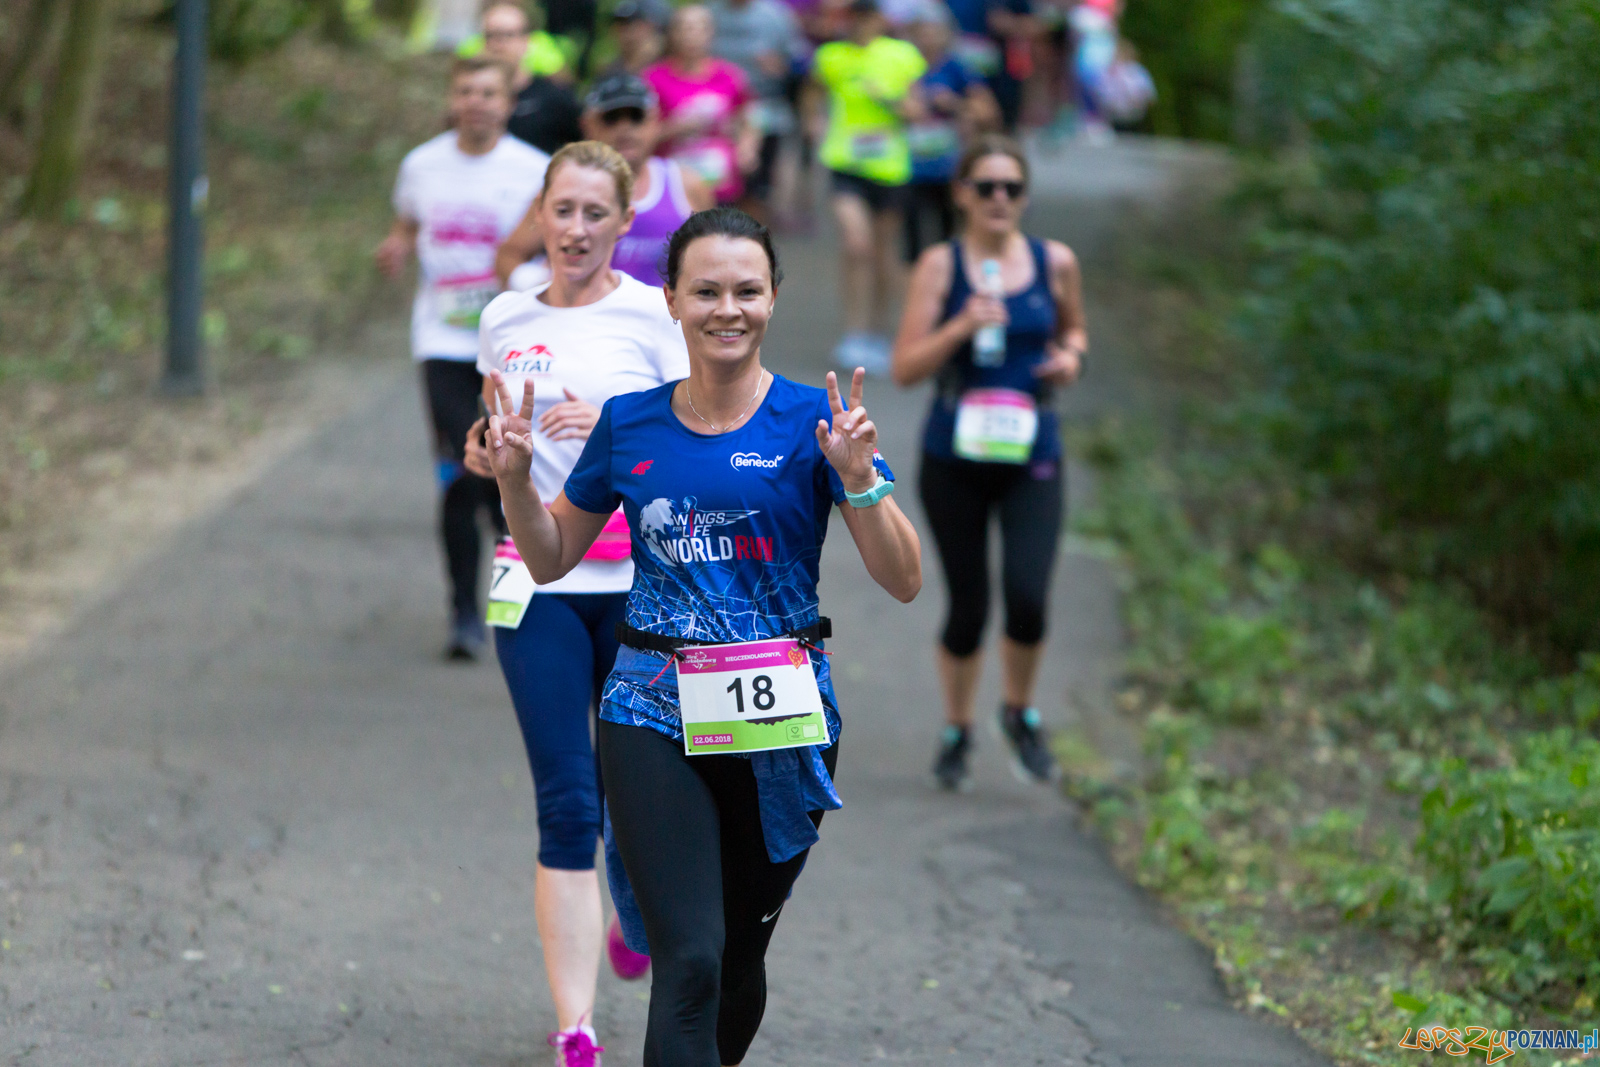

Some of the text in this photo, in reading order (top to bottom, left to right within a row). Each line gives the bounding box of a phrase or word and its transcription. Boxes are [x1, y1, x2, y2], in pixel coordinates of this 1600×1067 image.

[735, 456, 778, 468] Benecol
[672, 511, 726, 526] WINGS
[682, 525, 712, 538] LIFE
[661, 535, 773, 564] WORLD RUN
[492, 565, 510, 590] 7
[727, 674, 775, 713] 18
[694, 735, 732, 744] 22.06.2018
